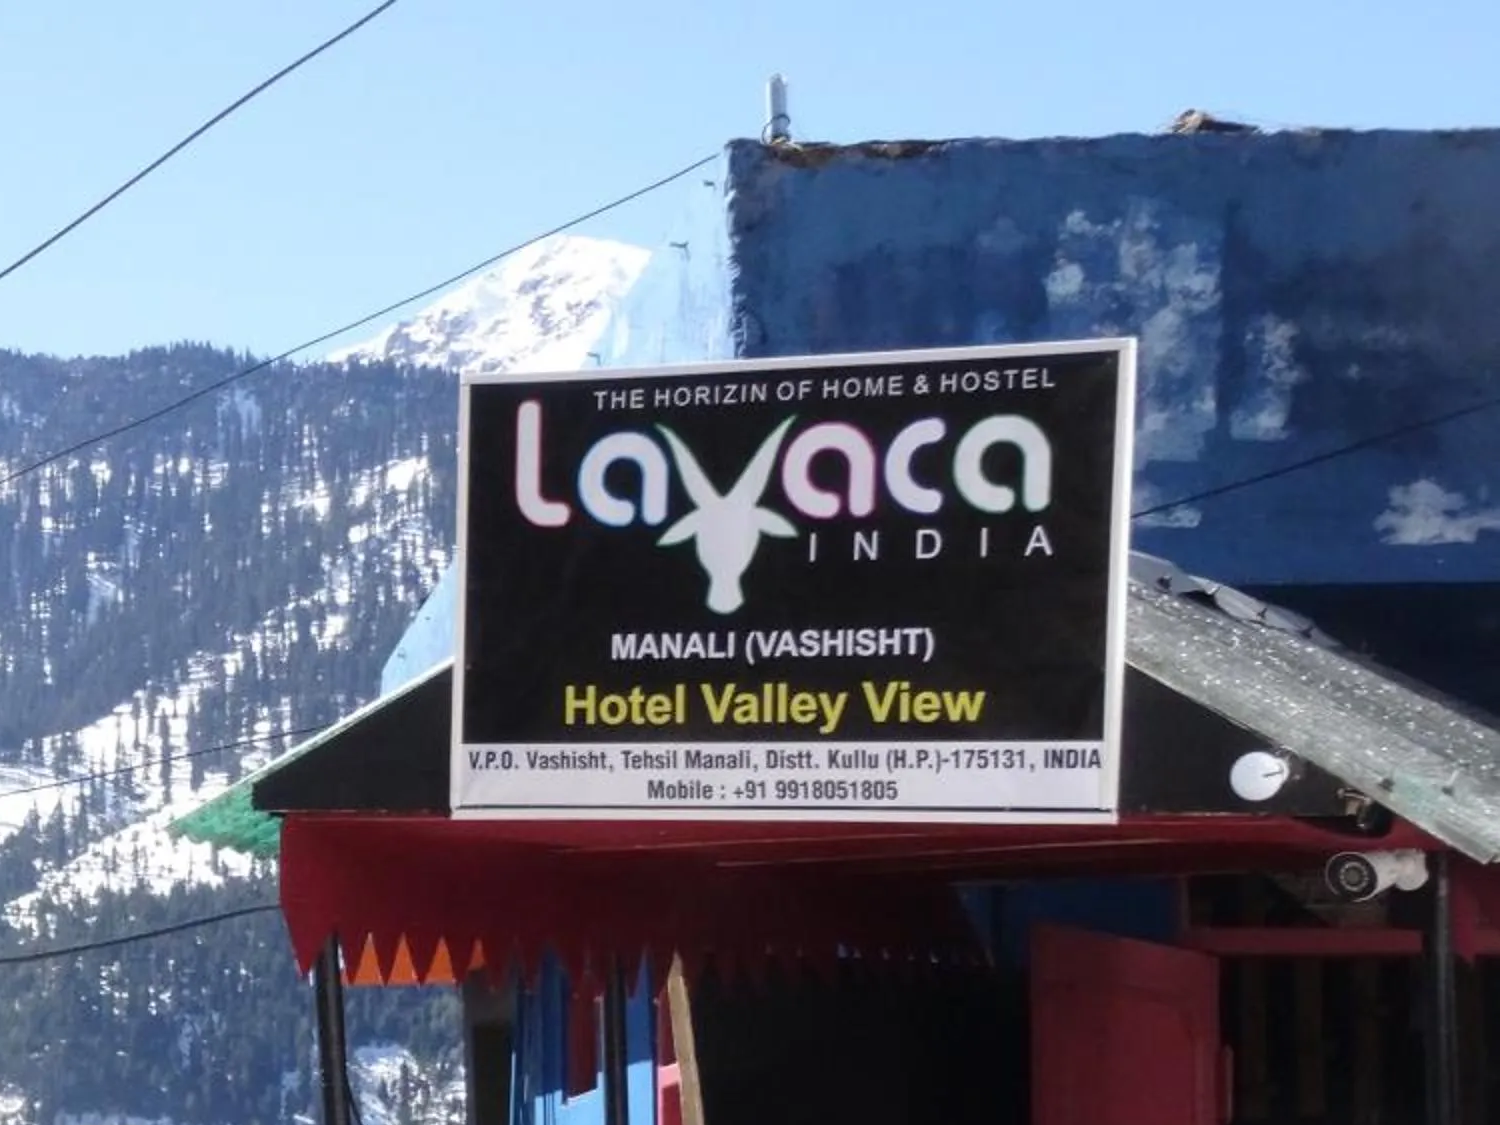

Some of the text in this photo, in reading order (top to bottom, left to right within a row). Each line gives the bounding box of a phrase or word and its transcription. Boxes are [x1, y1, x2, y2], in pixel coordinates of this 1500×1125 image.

[593, 367, 1056, 411] THE HORIZIN OF HOME & HOSTEL
[809, 525, 1053, 563] INDIA
[611, 627, 935, 665] MANALI (VASHISHT)
[565, 680, 986, 735] Hotel Valley View
[527, 749, 614, 773] Vashisht,
[620, 749, 678, 770] Tehsil
[684, 749, 758, 773] Manali,
[765, 749, 820, 770] Distt.
[827, 749, 879, 770] Kullu
[1043, 748, 1102, 769] INDIA
[647, 779, 714, 800] Mobile
[733, 779, 766, 800] +91
[775, 779, 898, 801] 9918051805
